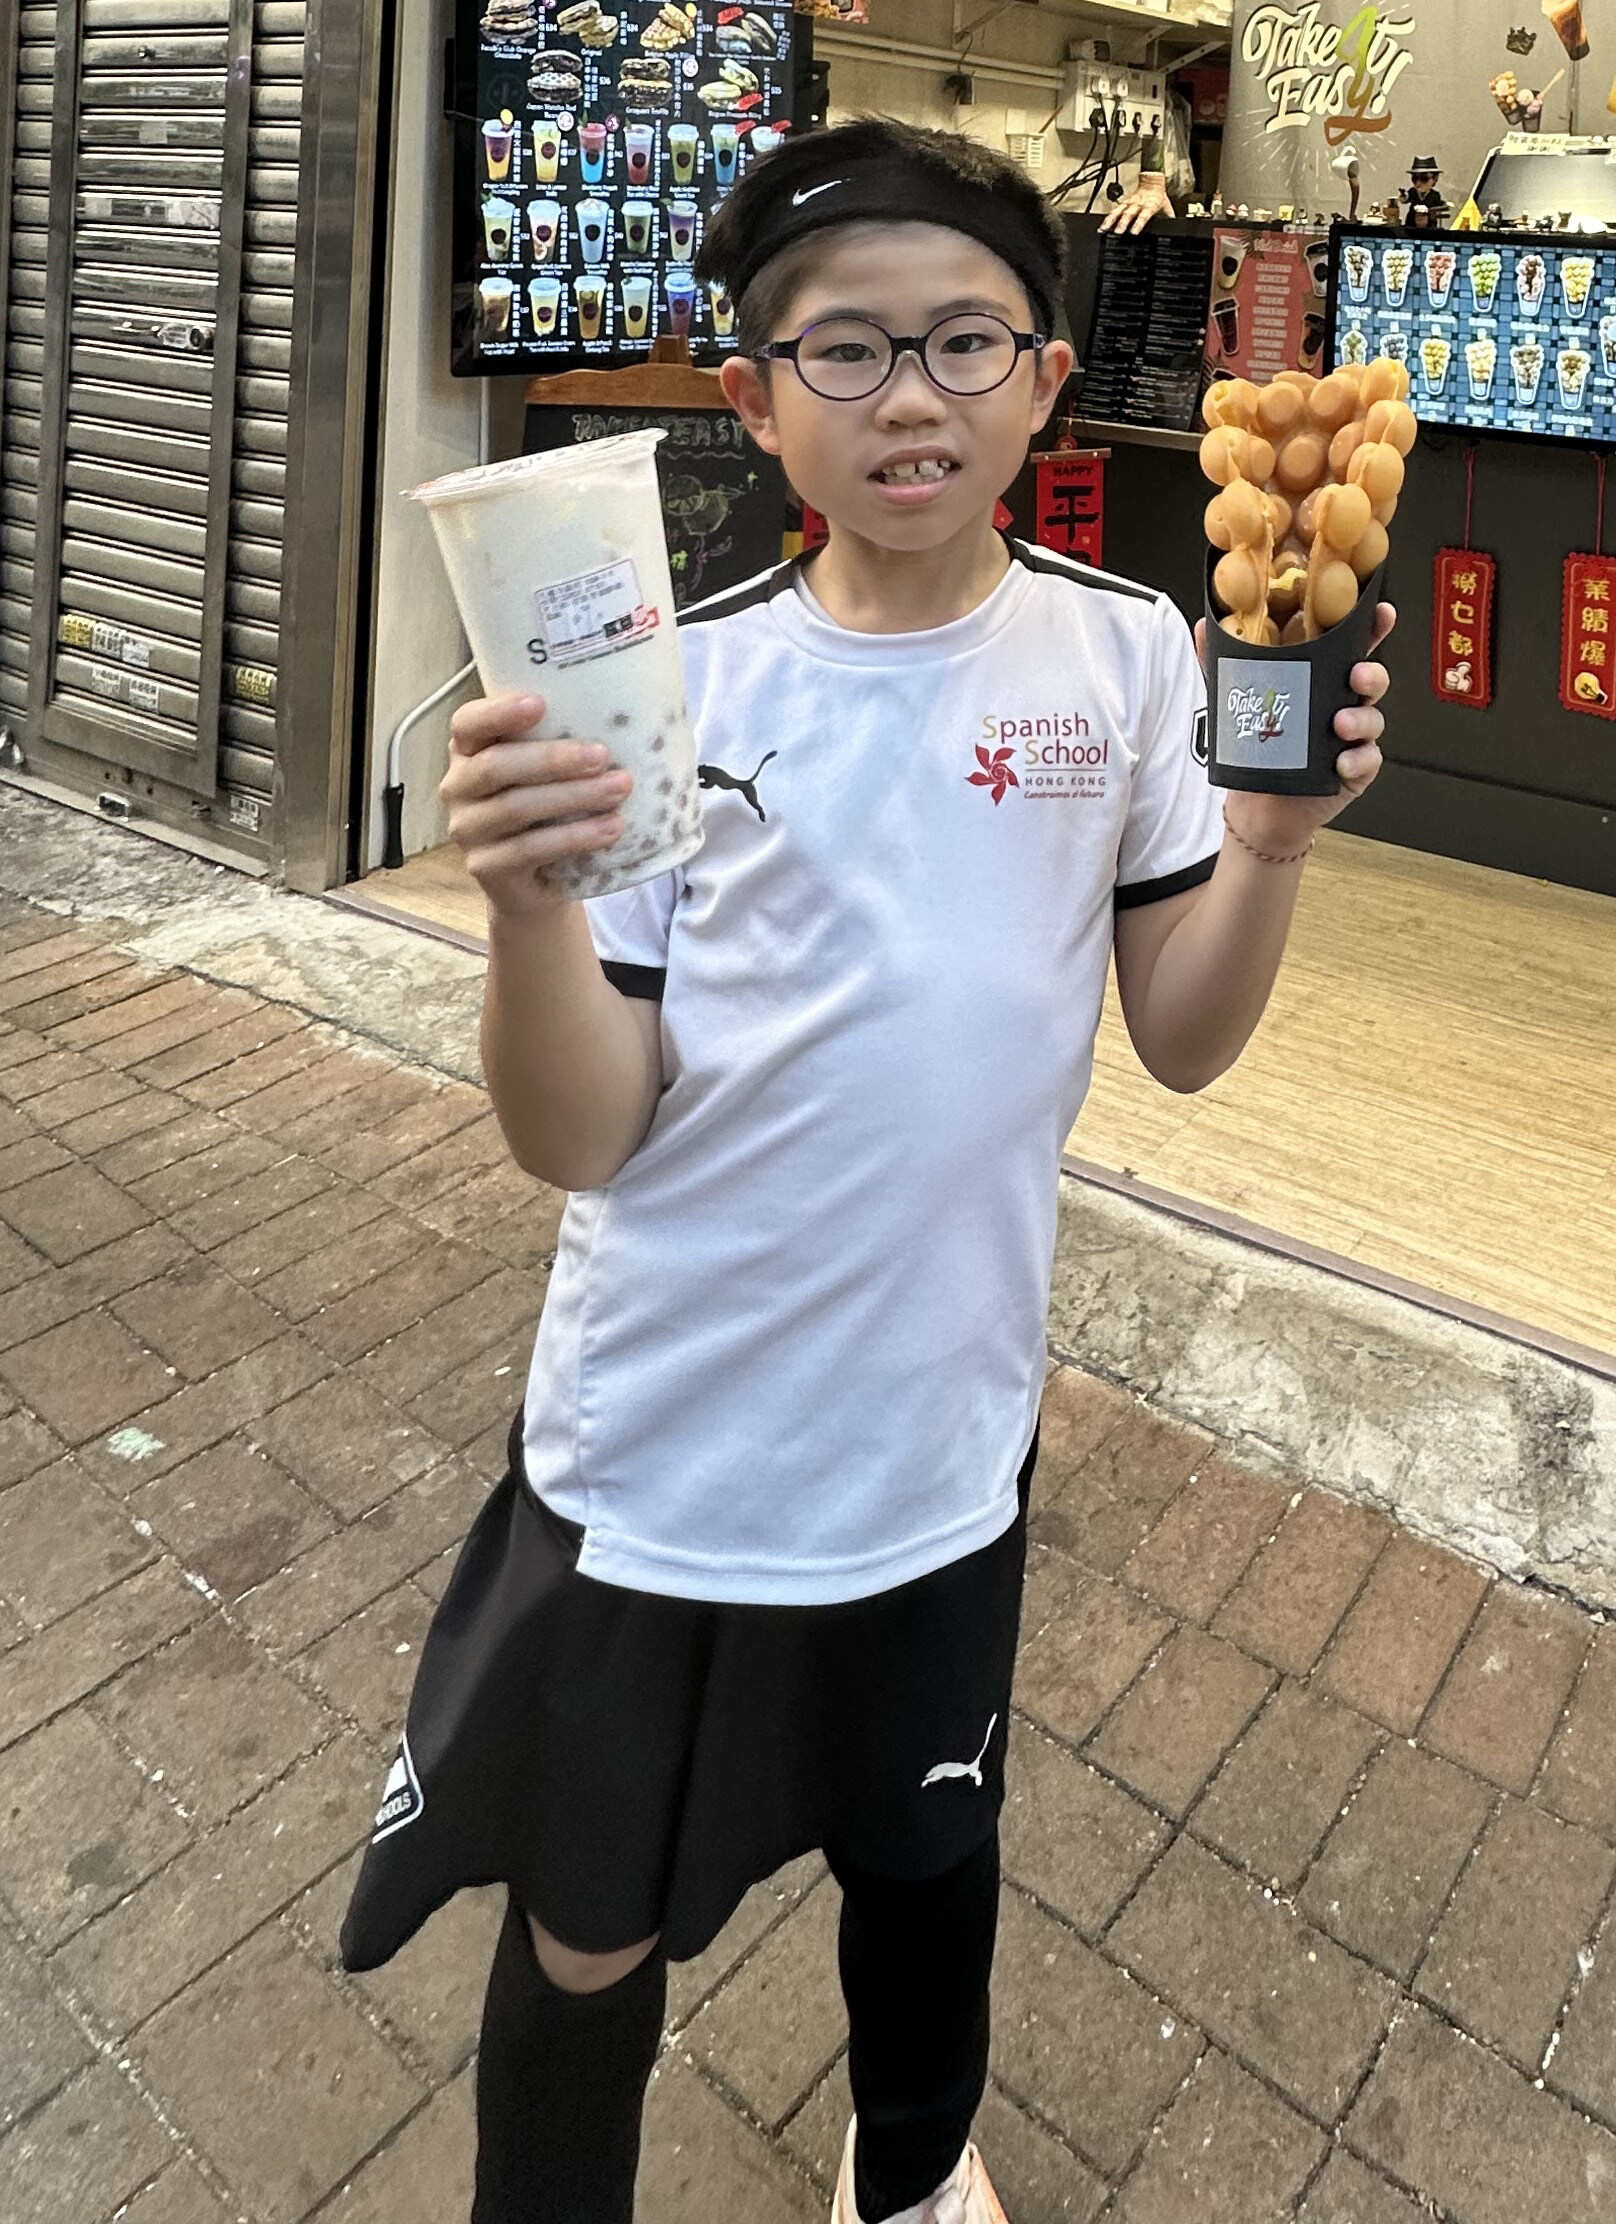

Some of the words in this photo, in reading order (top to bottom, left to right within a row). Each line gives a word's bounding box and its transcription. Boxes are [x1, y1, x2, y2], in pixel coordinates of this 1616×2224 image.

[1241, 1, 1343, 80] Take
[1265, 50, 1414, 146] Easy!
[1053, 465, 1094, 477] HAPPY
[1227, 686, 1264, 719] Take
[982, 711, 1090, 745] Spanish
[1024, 738, 1109, 766] School
[1024, 775, 1065, 787] HONG
[1070, 775, 1108, 787] KONG
